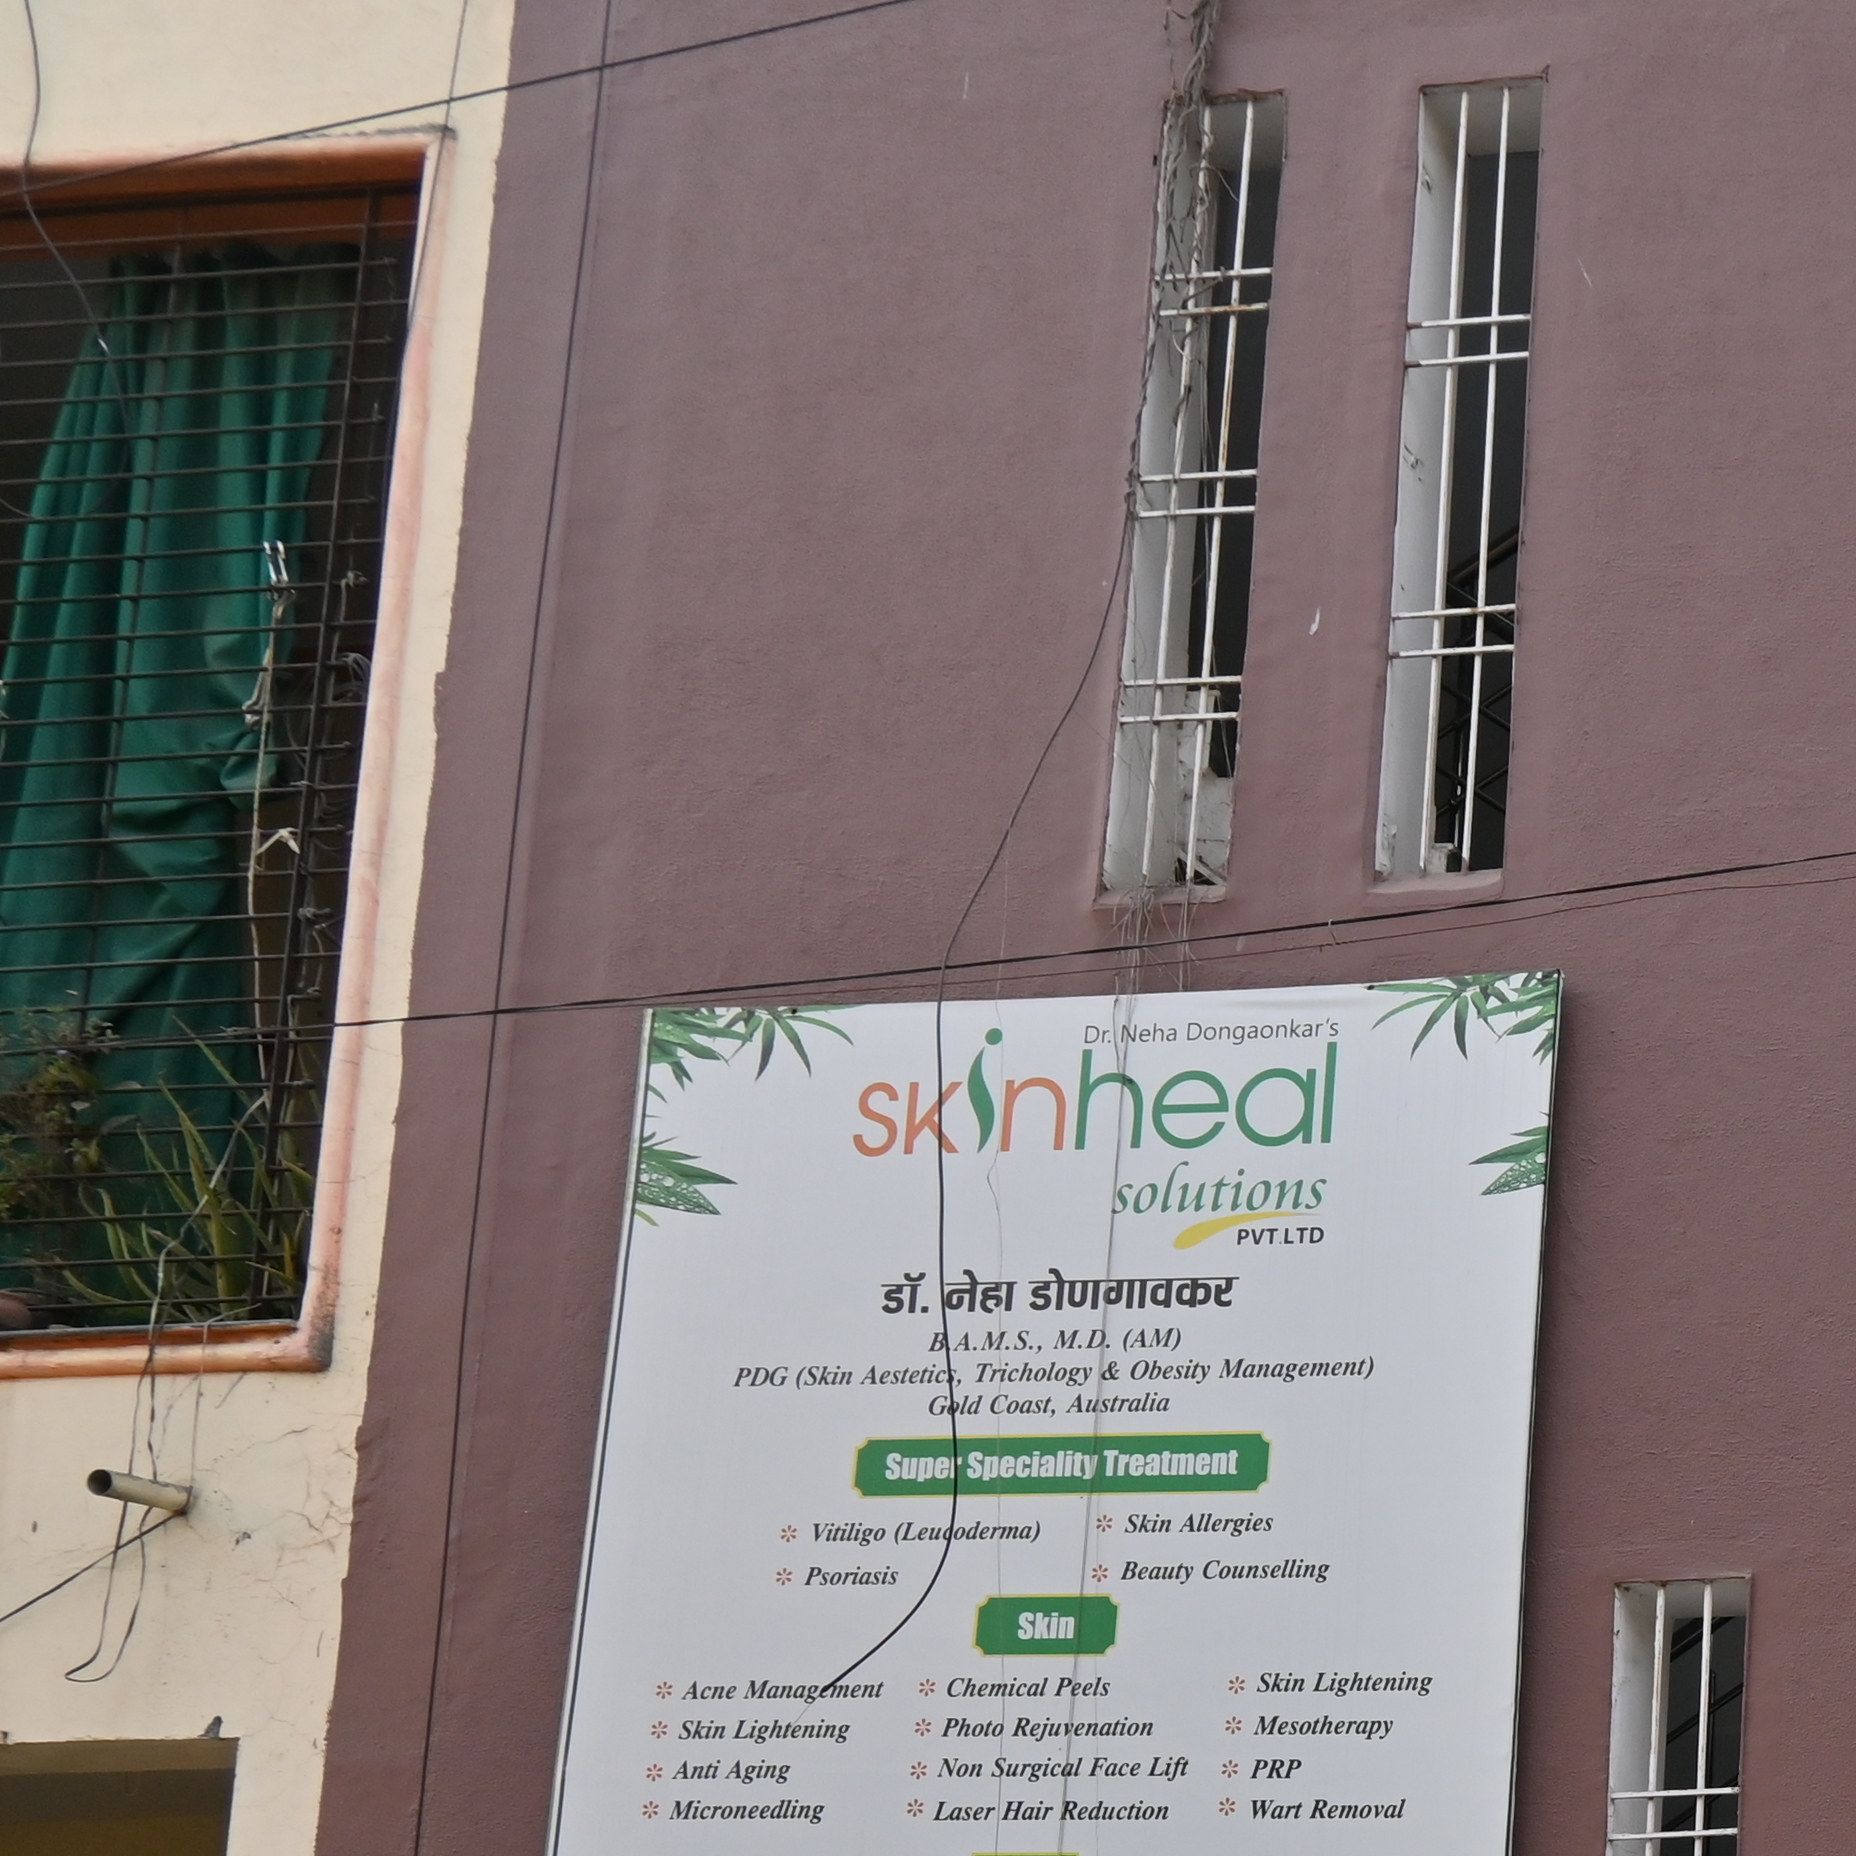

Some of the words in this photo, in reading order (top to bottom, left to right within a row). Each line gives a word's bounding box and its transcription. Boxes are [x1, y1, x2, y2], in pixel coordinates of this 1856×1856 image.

[1084, 1025, 1112, 1045] Dr.
[1120, 1024, 1178, 1044] Neha
[1186, 1017, 1339, 1045] Dongaonkar's
[1111, 1160, 1327, 1214] solutions
[945, 1269, 1018, 1312] नेहा
[1028, 1268, 1240, 1312] डोणगावकर
[1122, 1327, 1183, 1353] (AM)
[734, 1366, 788, 1387] PDG
[795, 1363, 854, 1390] (Skin
[974, 1361, 1093, 1390] Trichology
[1129, 1359, 1212, 1384] Obesity
[1218, 1356, 1375, 1384] Management)
[928, 1393, 982, 1417] Gold
[989, 1393, 1057, 1419] Coast,
[1066, 1392, 1171, 1416] Australia
[885, 1452, 961, 1483] Super
[966, 1450, 1097, 1481] Speciality
[1103, 1448, 1239, 1477] Treatment
[812, 1522, 887, 1546] Vitiligo
[894, 1520, 1041, 1545] (Leucoderma)
[1124, 1513, 1173, 1535] Skin
[1179, 1512, 1273, 1539] Allergies
[804, 1566, 899, 1588] Psoriasis
[1120, 1560, 1194, 1585] Beauty
[1201, 1558, 1330, 1583] Counselling
[1017, 1611, 1075, 1640] Skin
[682, 1682, 737, 1701] Acne
[744, 1680, 885, 1705] Management
[946, 1677, 1048, 1698] Chemical
[1054, 1677, 1111, 1698] Peels
[1256, 1672, 1305, 1694] Skin
[1312, 1670, 1433, 1697] Lightening
[678, 1720, 726, 1740] Skin
[733, 1718, 851, 1745] Lightening
[941, 1717, 1004, 1738] Photo
[1011, 1716, 1154, 1743] Rejuvenation
[1253, 1715, 1394, 1740] Mesotherapy
[672, 1760, 718, 1780] Anti
[726, 1760, 791, 1784] Aging
[937, 1757, 983, 1778] Non
[991, 1757, 1081, 1783] Surgical
[1089, 1757, 1141, 1778] Face
[1147, 1755, 1189, 1777] Lift
[1250, 1758, 1302, 1780] PRP
[669, 1800, 826, 1825] Microneedling
[932, 1801, 995, 1822] Laser
[1002, 1801, 1053, 1821] Hair
[1060, 1799, 1169, 1821] Reduction
[1250, 1799, 1303, 1820] Wart
[1309, 1797, 1407, 1820] Removal
